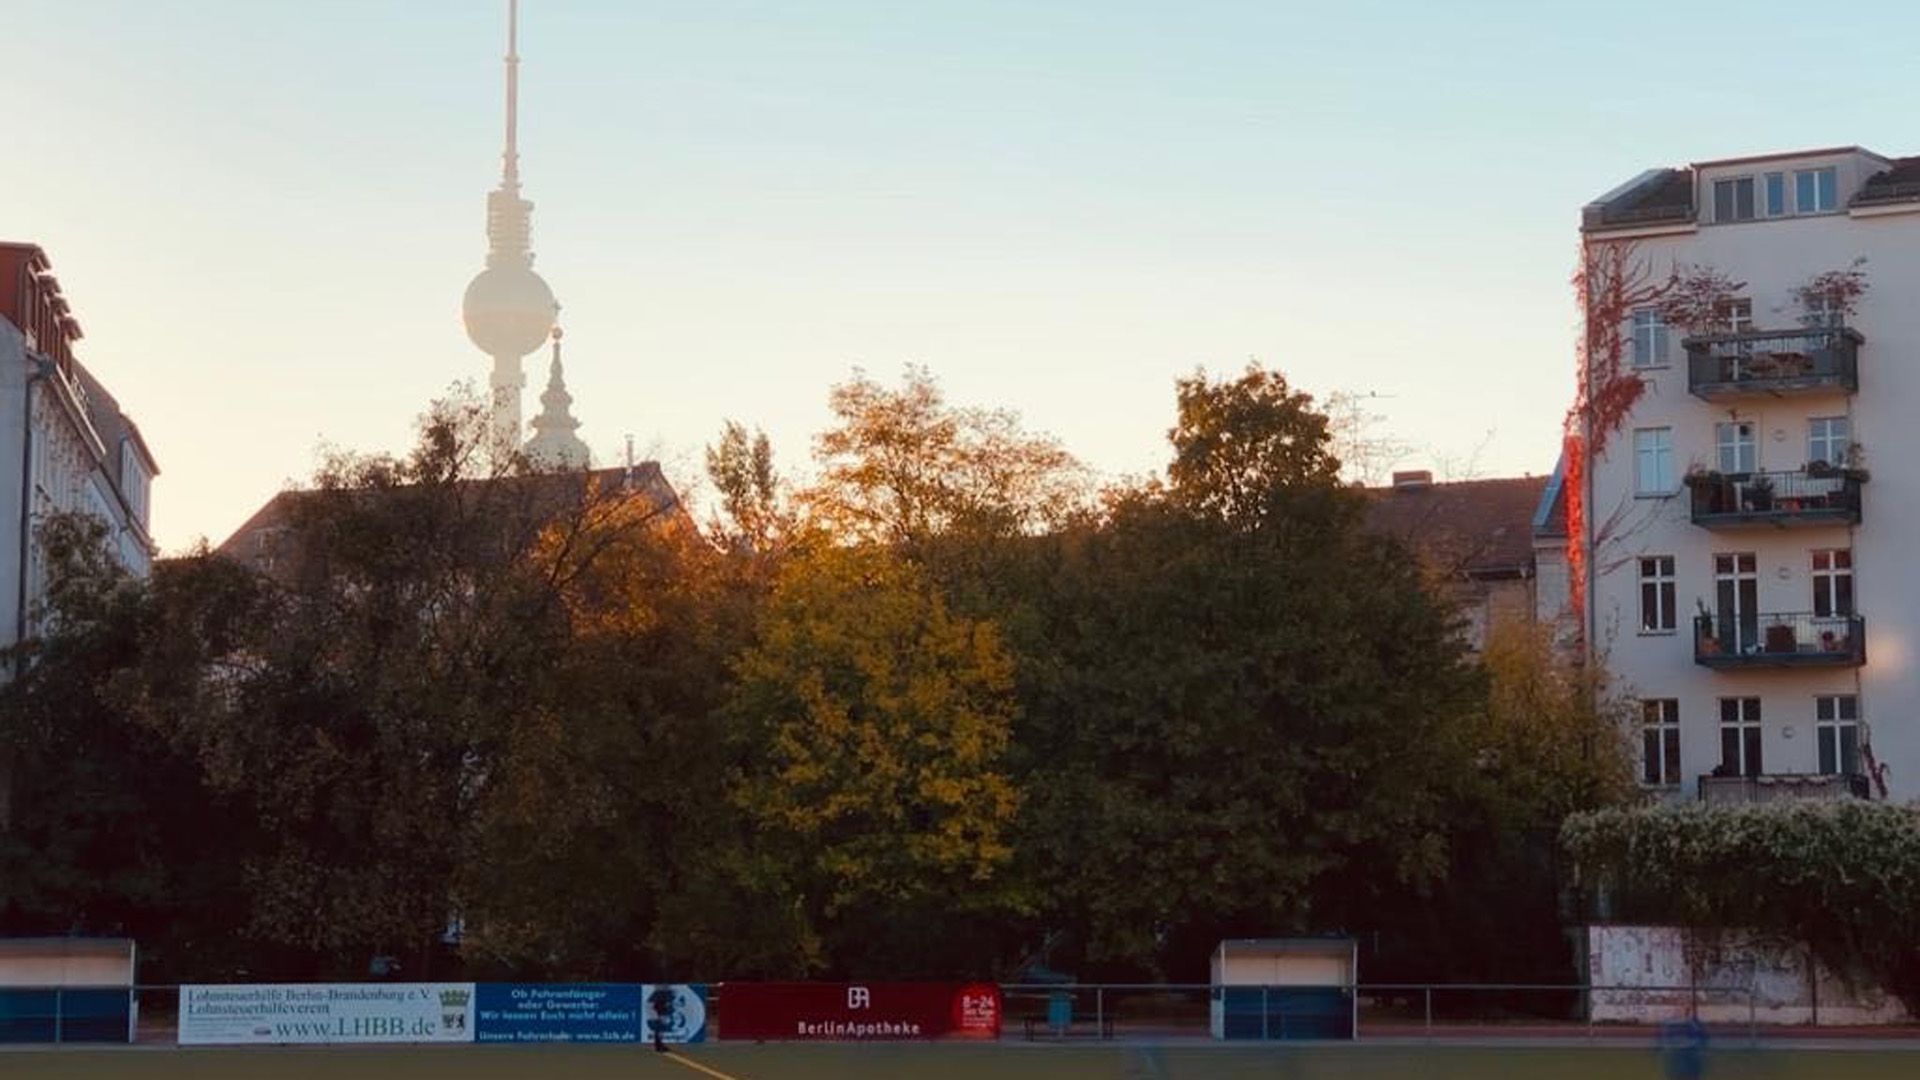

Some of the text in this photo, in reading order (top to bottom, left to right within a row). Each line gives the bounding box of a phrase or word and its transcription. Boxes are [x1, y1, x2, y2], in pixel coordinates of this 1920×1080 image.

[187, 988, 283, 1001] Lohnsteuerhilfe
[285, 987, 405, 1002] Berlin-Brandenburg
[511, 988, 528, 999] Ob
[187, 1002, 330, 1015] Lohnsteuerhilfeverein
[517, 1000, 543, 1009] oder
[480, 1010, 499, 1019] Wir
[541, 1010, 565, 1020] Euch
[568, 1010, 596, 1020] nicht
[276, 1017, 436, 1037] www.LHBB.de
[798, 1021, 920, 1036] BerlinApotheke
[479, 1031, 514, 1040] Unsere
